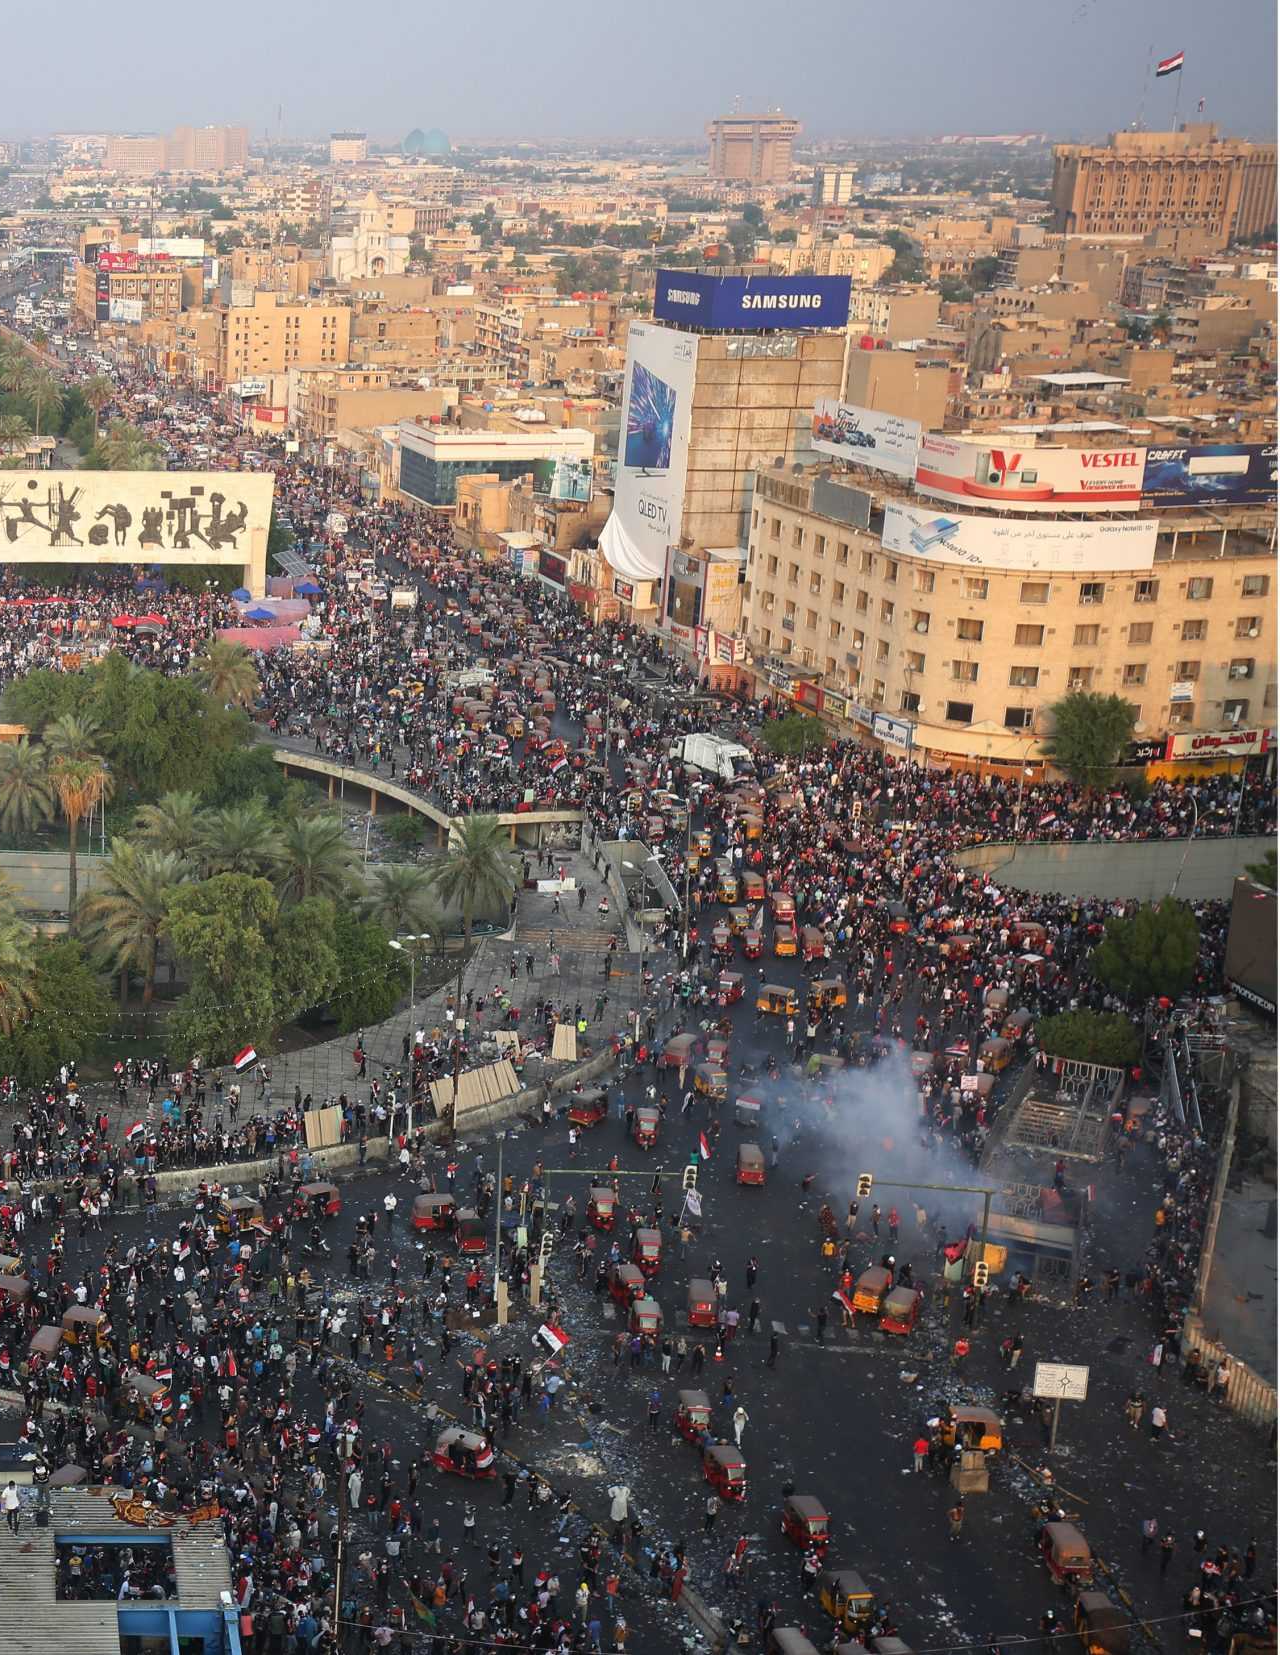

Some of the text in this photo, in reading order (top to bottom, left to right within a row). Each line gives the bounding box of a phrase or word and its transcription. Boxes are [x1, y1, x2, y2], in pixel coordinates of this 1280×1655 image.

[667, 289, 701, 306] SAMSUNG
[742, 295, 822, 309] SAMSUNG
[834, 408, 860, 432] Ford
[1080, 453, 1139, 467] VESTEL
[639, 499, 668, 522] QLED TV
